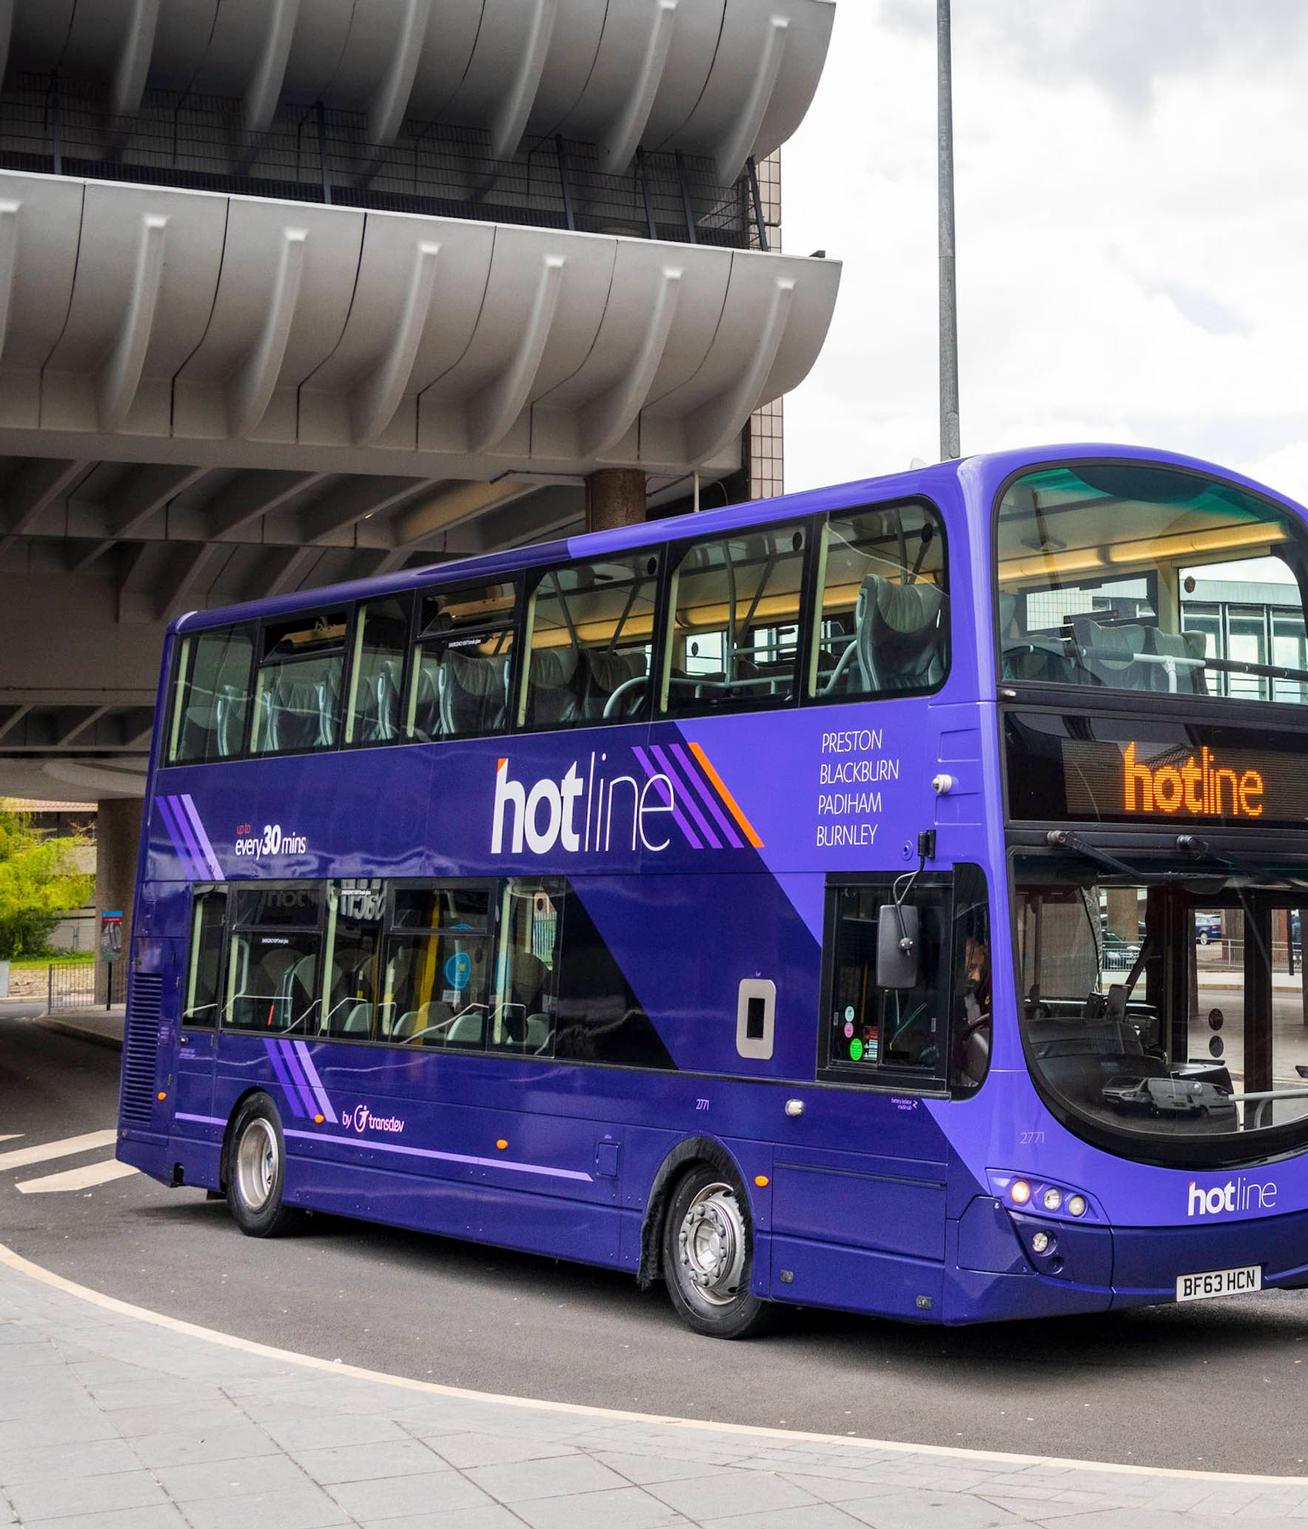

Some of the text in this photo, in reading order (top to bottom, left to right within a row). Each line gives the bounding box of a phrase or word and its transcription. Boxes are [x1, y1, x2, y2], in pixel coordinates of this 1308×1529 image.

[821, 728, 883, 753] PRESTON
[820, 759, 900, 785] BLACKBURN
[1124, 740, 1264, 816] hotline
[491, 752, 675, 854] hotline
[818, 792, 882, 815] PADIHAM
[235, 824, 306, 861] every 30 mins
[816, 823, 878, 847] BURNLEY
[342, 1110, 405, 1132] by transdev
[1020, 1131, 1045, 1145] 2771
[1187, 1177, 1278, 1216] hotline
[1183, 1269, 1256, 1297] BF63 HCN
